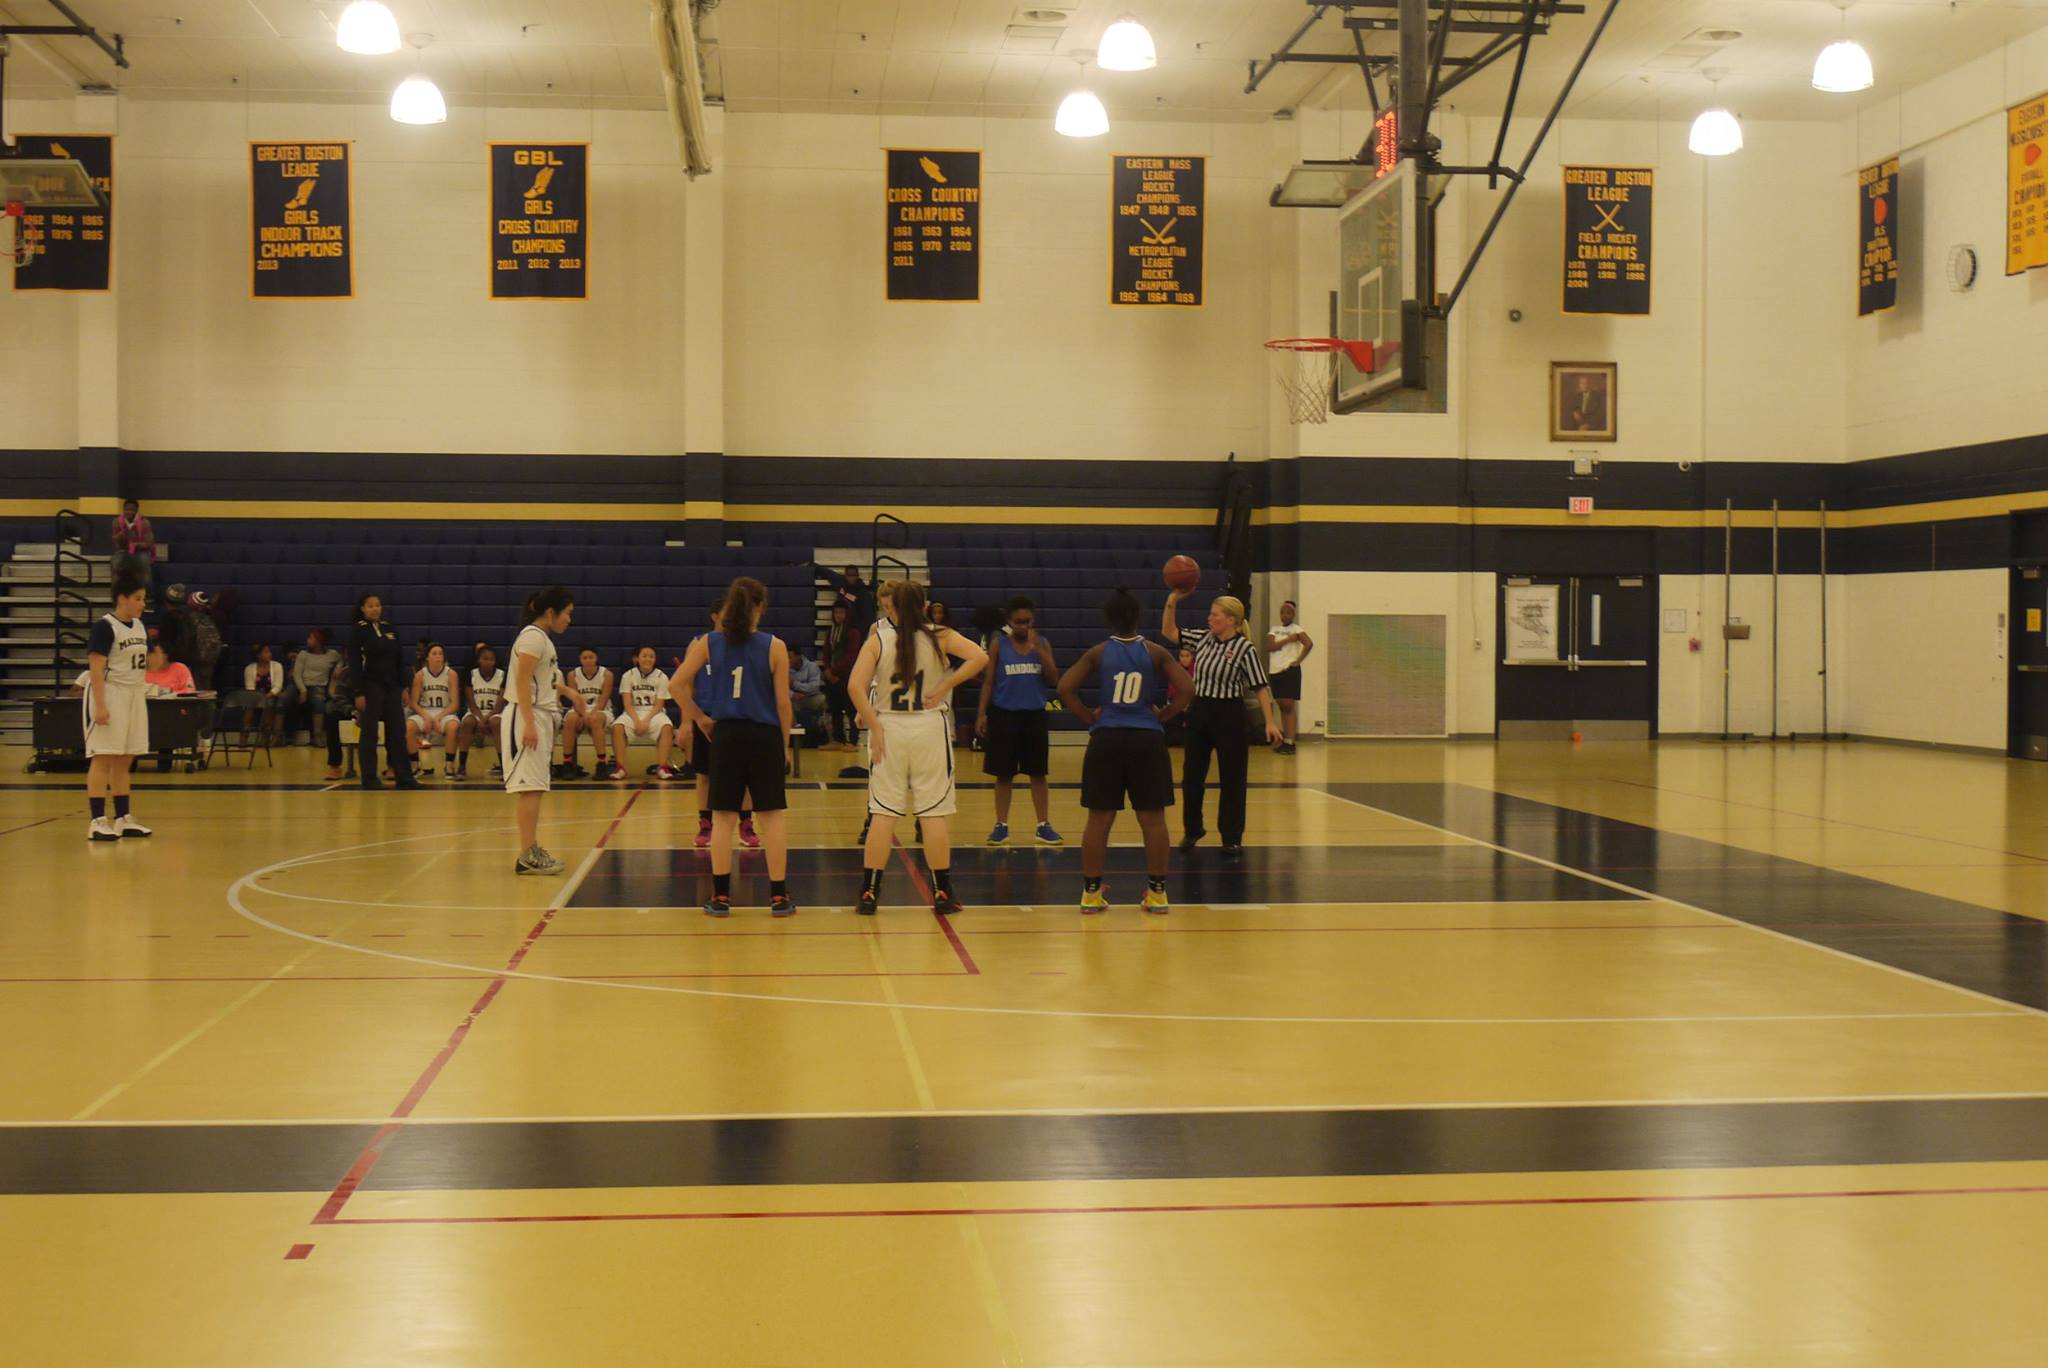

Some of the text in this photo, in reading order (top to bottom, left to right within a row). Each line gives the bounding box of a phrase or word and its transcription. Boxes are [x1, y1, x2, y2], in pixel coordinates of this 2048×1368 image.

[257, 146, 344, 161] GREATER BOSTON
[514, 150, 564, 166] GBL
[282, 162, 320, 177] LEAGUE
[1126, 159, 1192, 170] EASTERN MASS
[1142, 170, 1175, 181] LEAGUE
[1566, 170, 1652, 186] GREATER BOSTON
[1142, 182, 1175, 192] HOCKEY
[888, 188, 978, 202] CROSS COUNTRY
[1136, 194, 1180, 204] CHAMPIONS
[1588, 187, 1630, 202] LEAGUE
[524, 200, 553, 214] GIRLS
[284, 210, 319, 224] GIRLS
[901, 207, 966, 222] CHAMPIONS
[498, 219, 578, 234] CROSS COUNTRY
[260, 226, 342, 242] INDOOR TRACK
[1578, 232, 1638, 244] FIELD HOCKEY
[261, 242, 343, 258] CHAMPIONS
[512, 239, 566, 254] CHAMPIONS
[1129, 246, 1187, 256] METROPOLITAN
[1578, 245, 1638, 260] CHAMPIONS
[497, 258, 582, 270] 2011 2012 2013
[1142, 257, 1174, 268] LEAGUE
[1142, 269, 1174, 279] HOCKEY
[1136, 280, 1180, 291] CHAMPIONS
[1573, 499, 1590, 512] EXIT
[131, 654, 146, 670] 12
[732, 666, 744, 698] 1
[1112, 672, 1143, 704] 10
[890, 669, 924, 710] 21
[480, 700, 494, 710] 15
